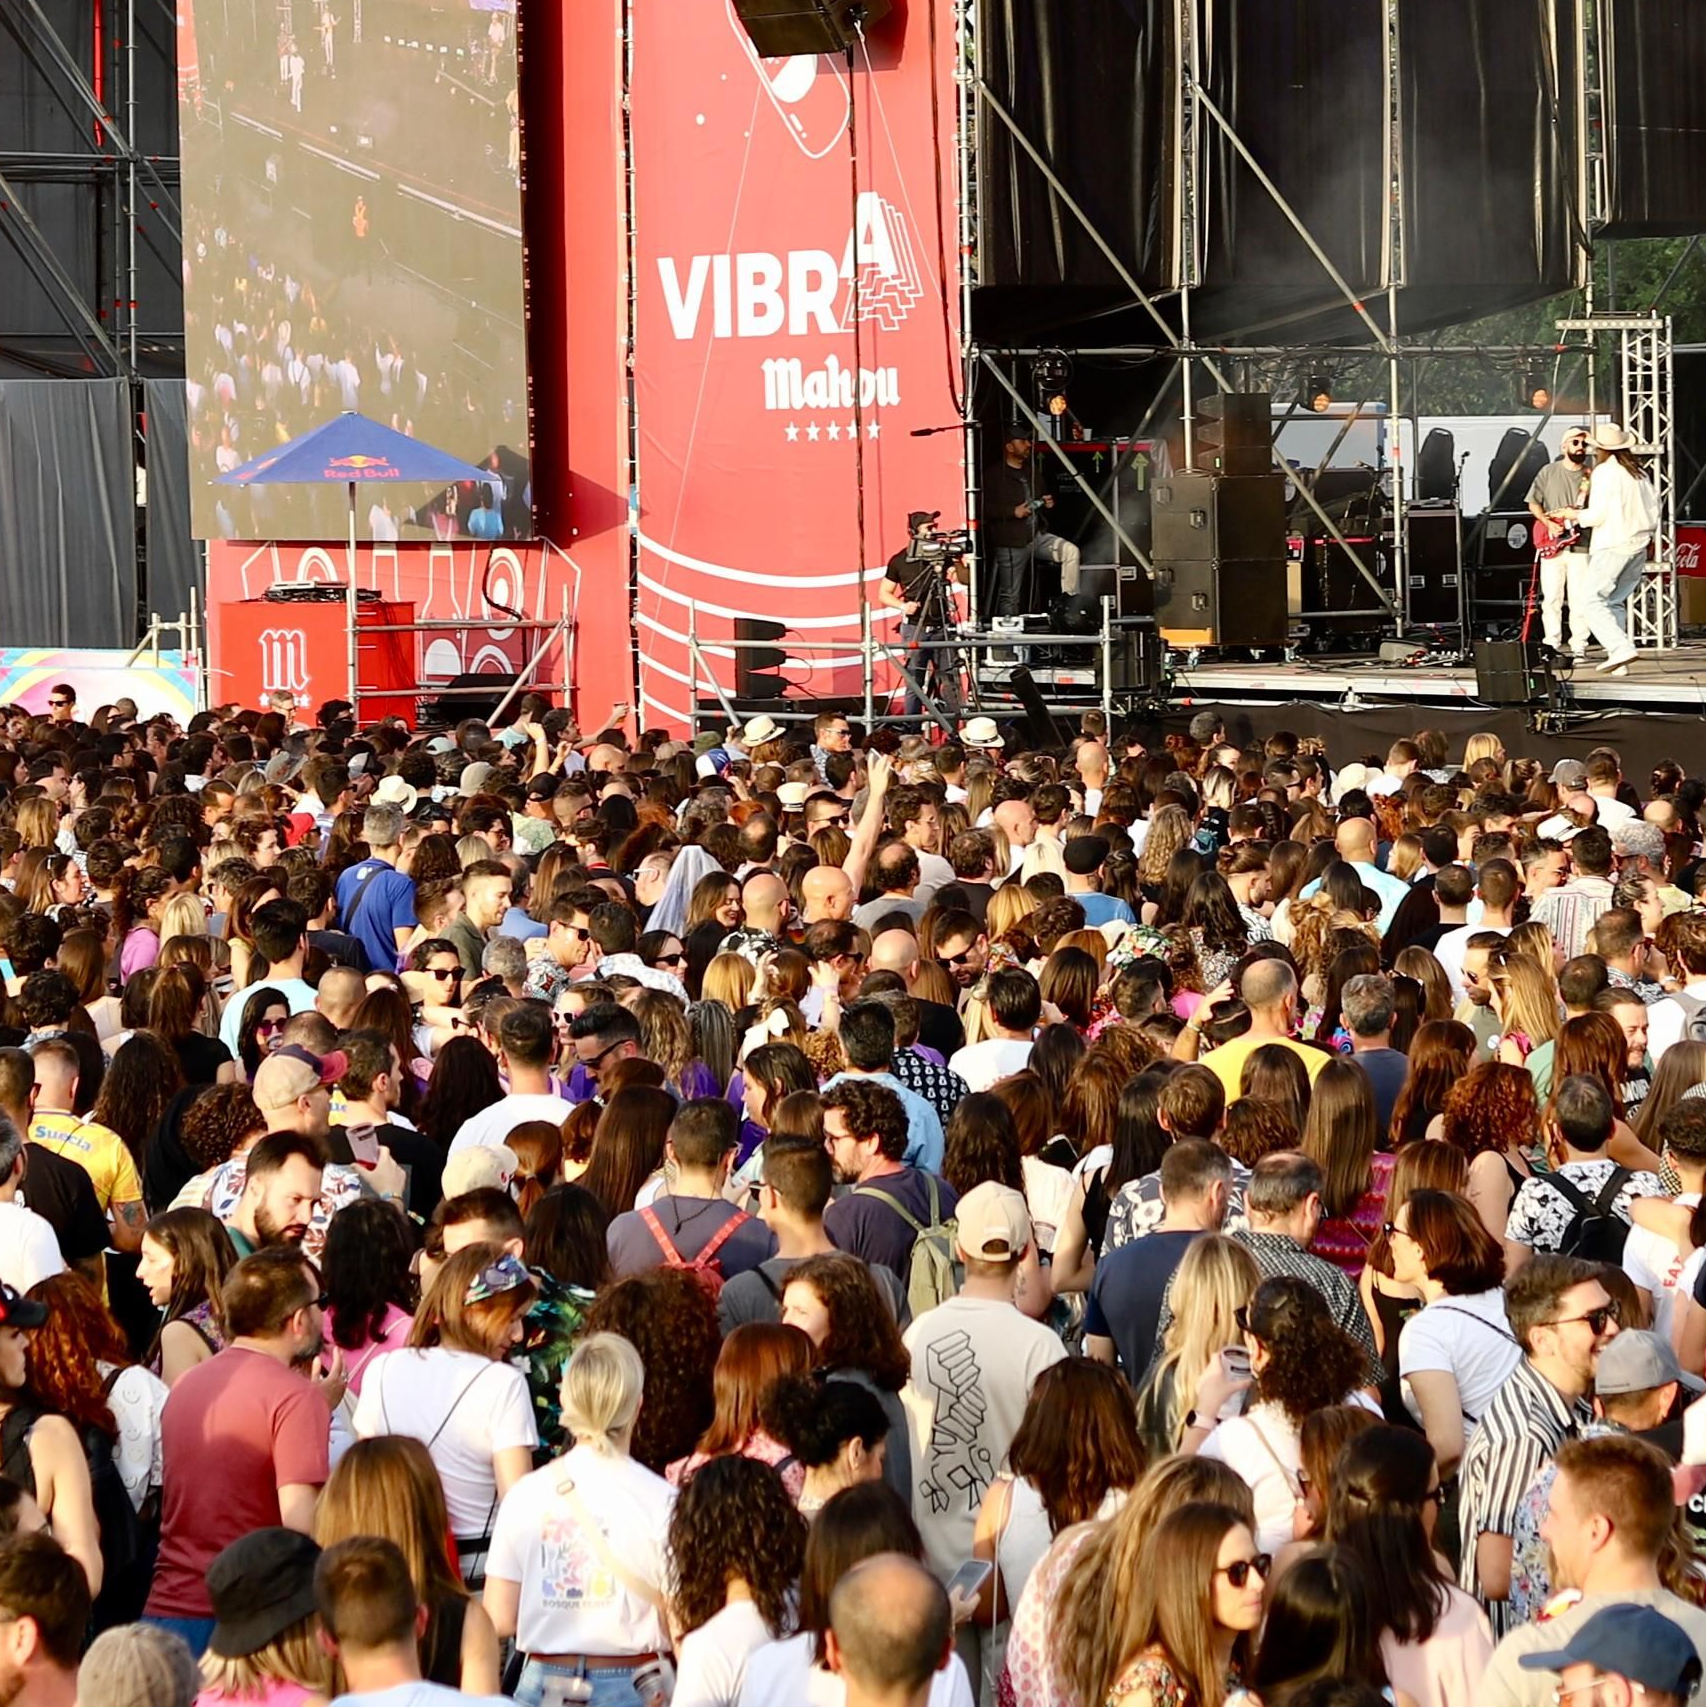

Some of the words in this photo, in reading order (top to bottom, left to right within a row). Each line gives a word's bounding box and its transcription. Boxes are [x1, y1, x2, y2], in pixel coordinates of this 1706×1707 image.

[657, 191, 924, 339] VIBRA
[762, 353, 901, 410] Mahou
[324, 468, 361, 478] Red
[362, 467, 401, 478] Bull
[34, 1125, 92, 1153] Suecia
